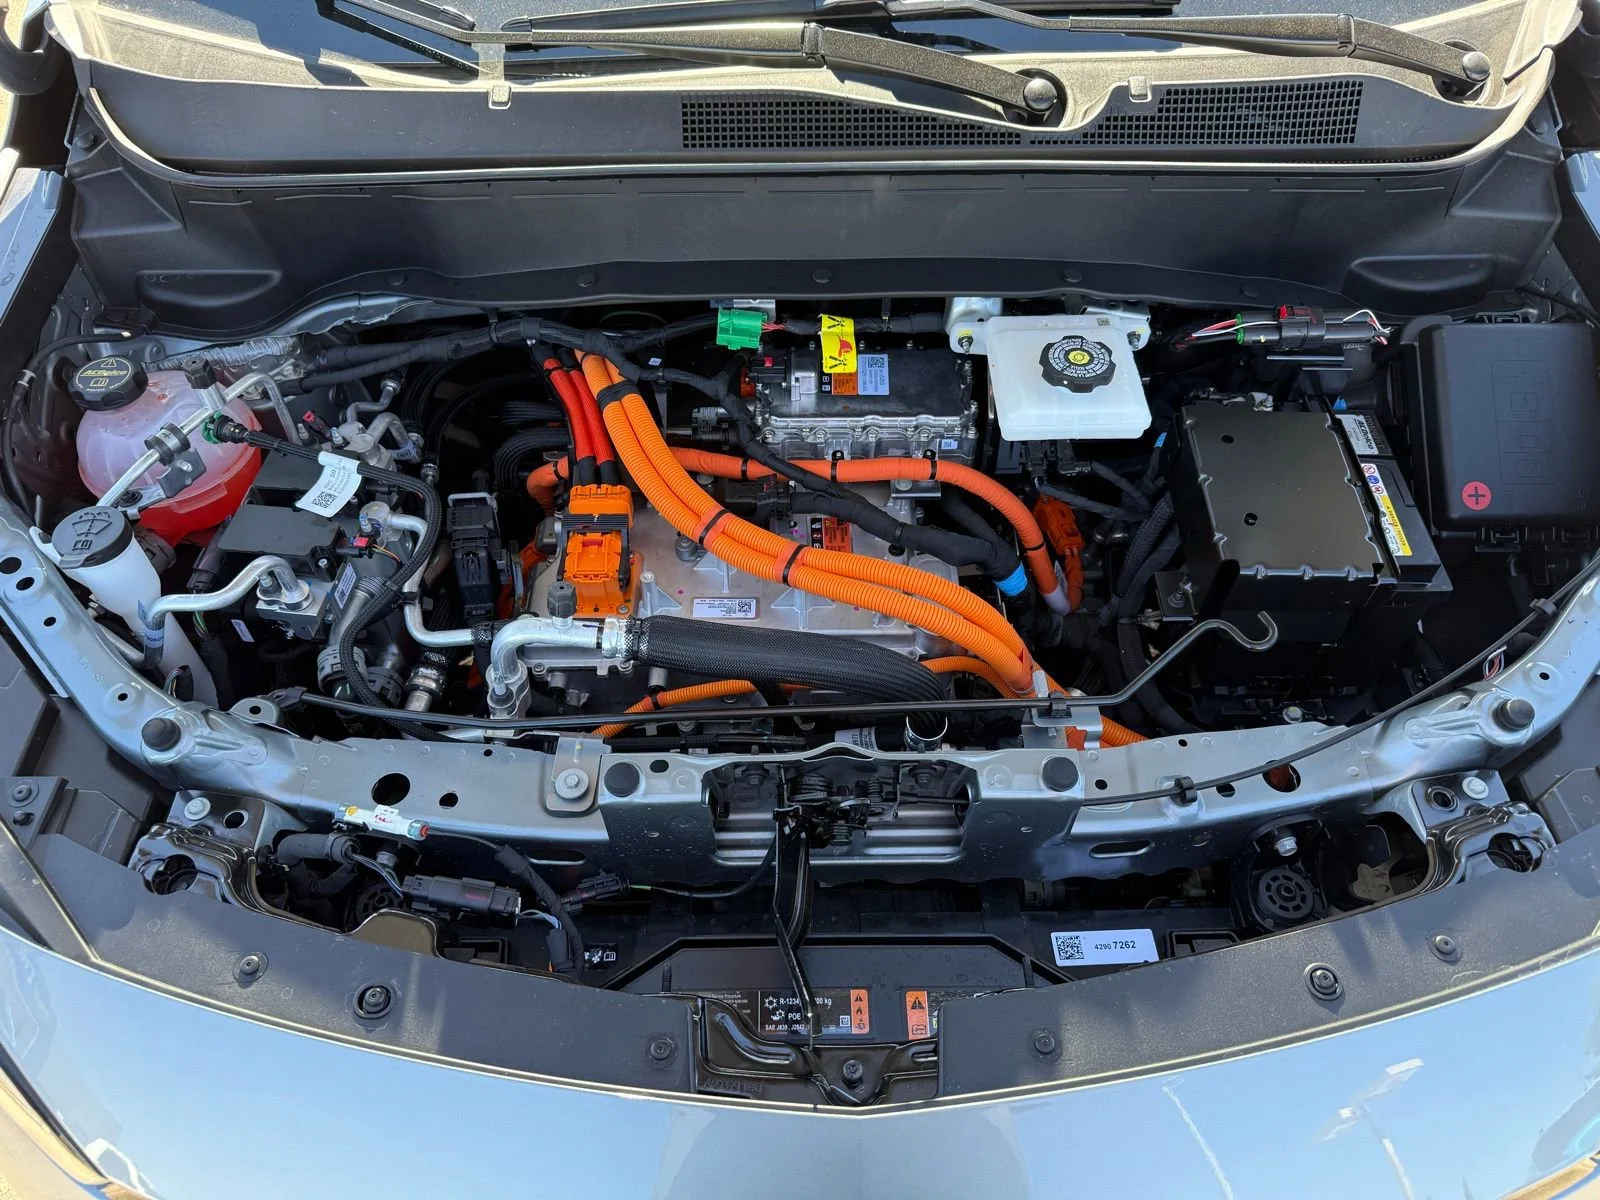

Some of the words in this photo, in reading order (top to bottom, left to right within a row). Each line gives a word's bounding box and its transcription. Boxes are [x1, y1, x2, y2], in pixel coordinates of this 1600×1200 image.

[1356, 418, 1374, 450] ACDelco
[1112, 940, 1137, 949] 7262
[780, 998, 801, 1006] R-1234
[824, 997, 832, 1006] kg
